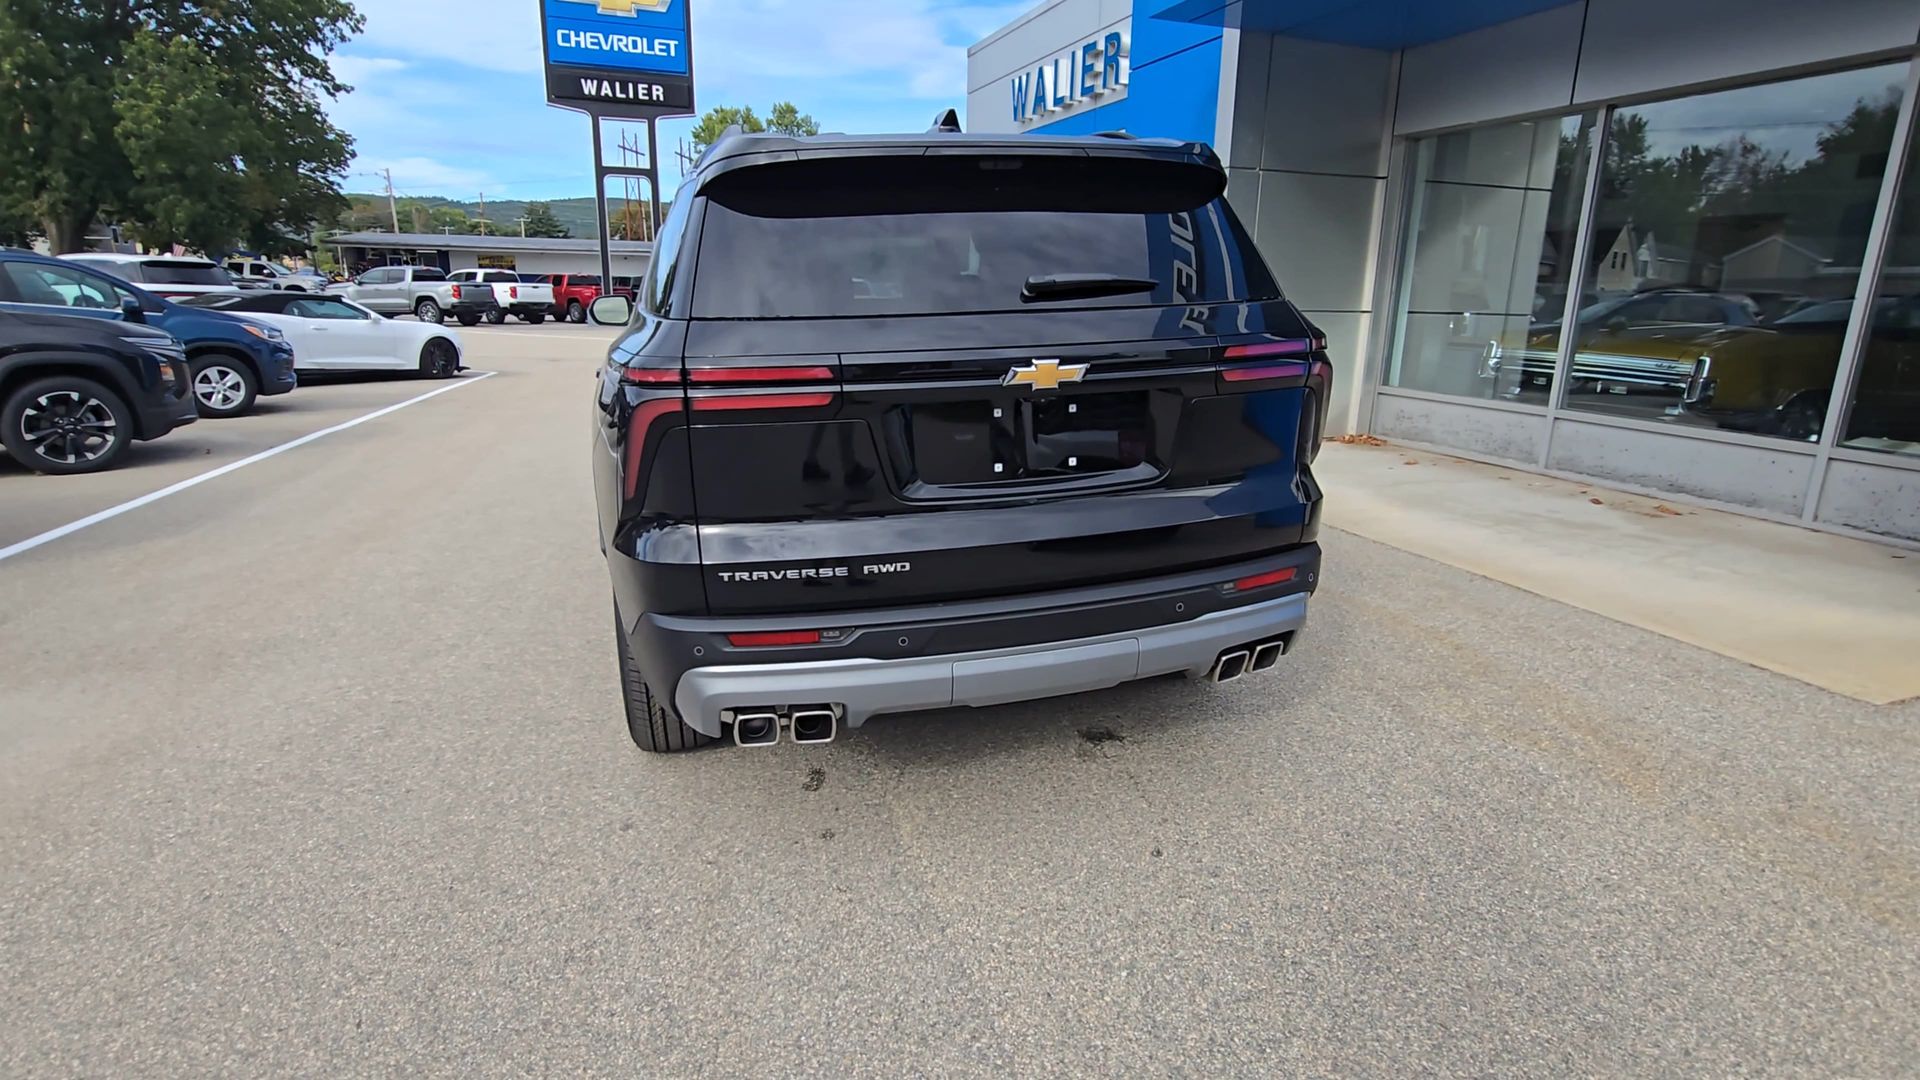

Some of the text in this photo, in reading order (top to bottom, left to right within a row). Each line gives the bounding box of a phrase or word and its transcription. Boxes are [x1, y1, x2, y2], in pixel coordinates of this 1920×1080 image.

[556, 29, 679, 57] CHEVROLET
[1011, 31, 1123, 122] WALIER
[580, 78, 665, 102] WALIER
[718, 562, 911, 582] TRAVERSE AWD
